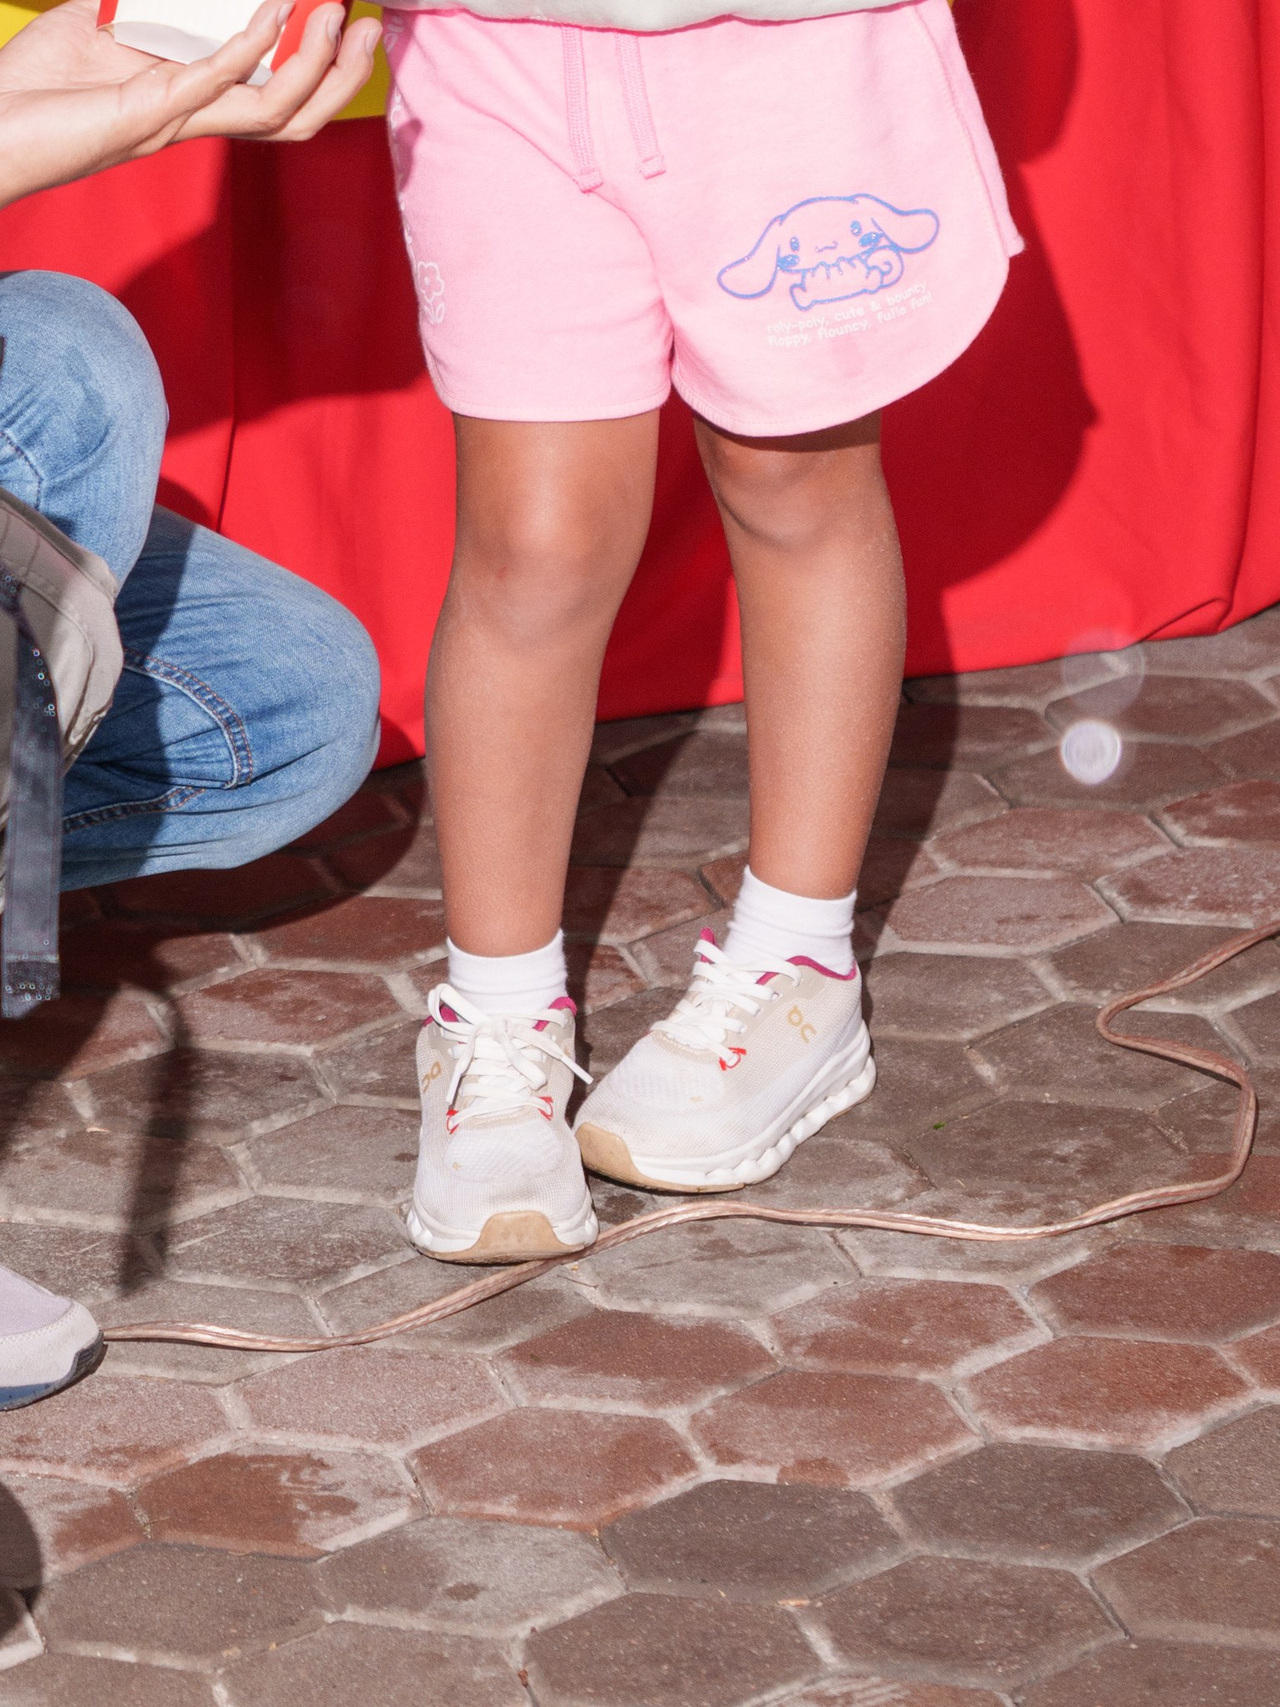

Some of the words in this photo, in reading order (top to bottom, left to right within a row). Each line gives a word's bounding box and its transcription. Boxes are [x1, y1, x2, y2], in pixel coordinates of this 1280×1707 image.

[765, 314, 830, 334] roly-poly,
[834, 306, 865, 322] cute
[871, 301, 881, 312] &
[887, 282, 928, 305] bouncy
[768, 333, 812, 348] floppy,
[817, 319, 872, 341] flouncy,
[876, 306, 908, 325] fulla
[911, 292, 934, 309] fun!
